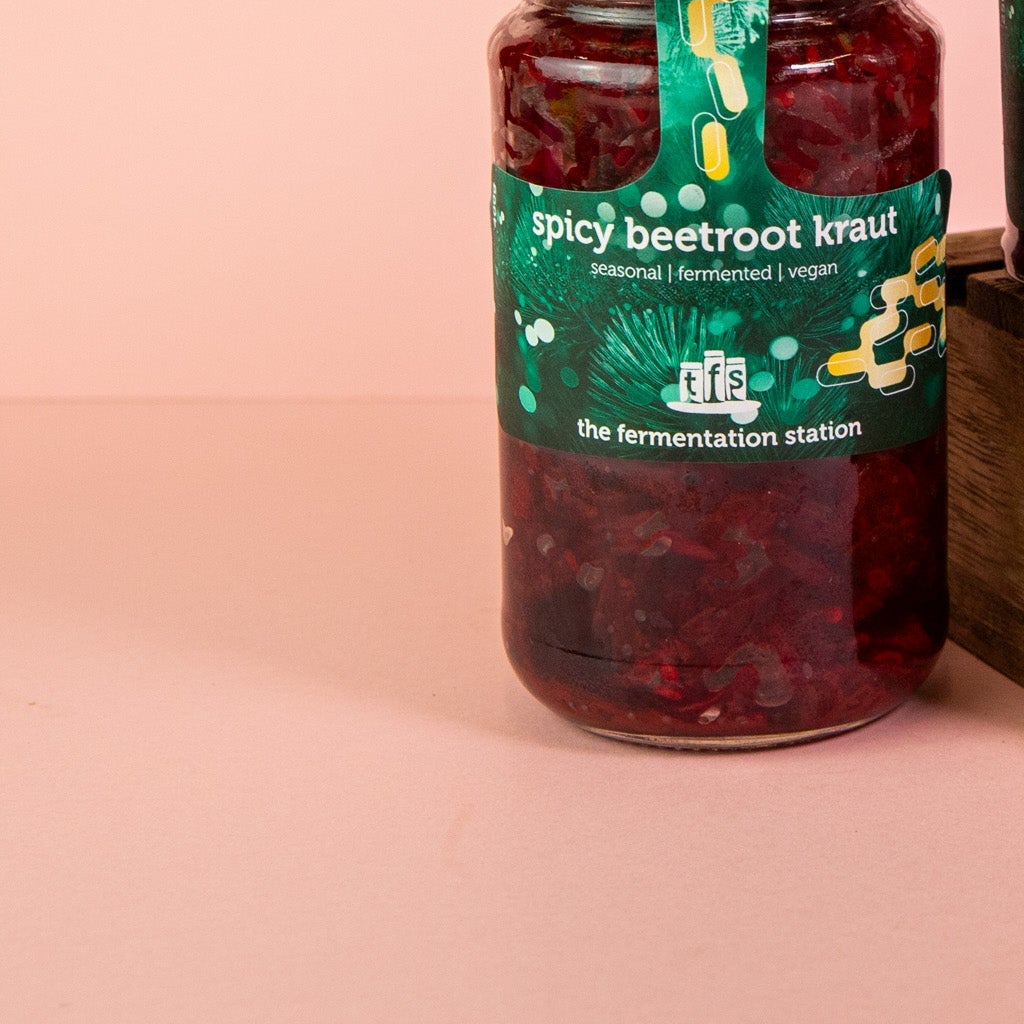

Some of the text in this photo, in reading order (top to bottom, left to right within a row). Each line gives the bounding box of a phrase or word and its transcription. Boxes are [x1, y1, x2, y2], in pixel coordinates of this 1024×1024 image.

[531, 205, 898, 255] spicy beetroot kraut
[590, 262, 662, 280] seasonal
[678, 265, 772, 282] fermented
[787, 262, 838, 281] vegan
[682, 362, 746, 403] tfs
[577, 417, 862, 448] the fermentation station
